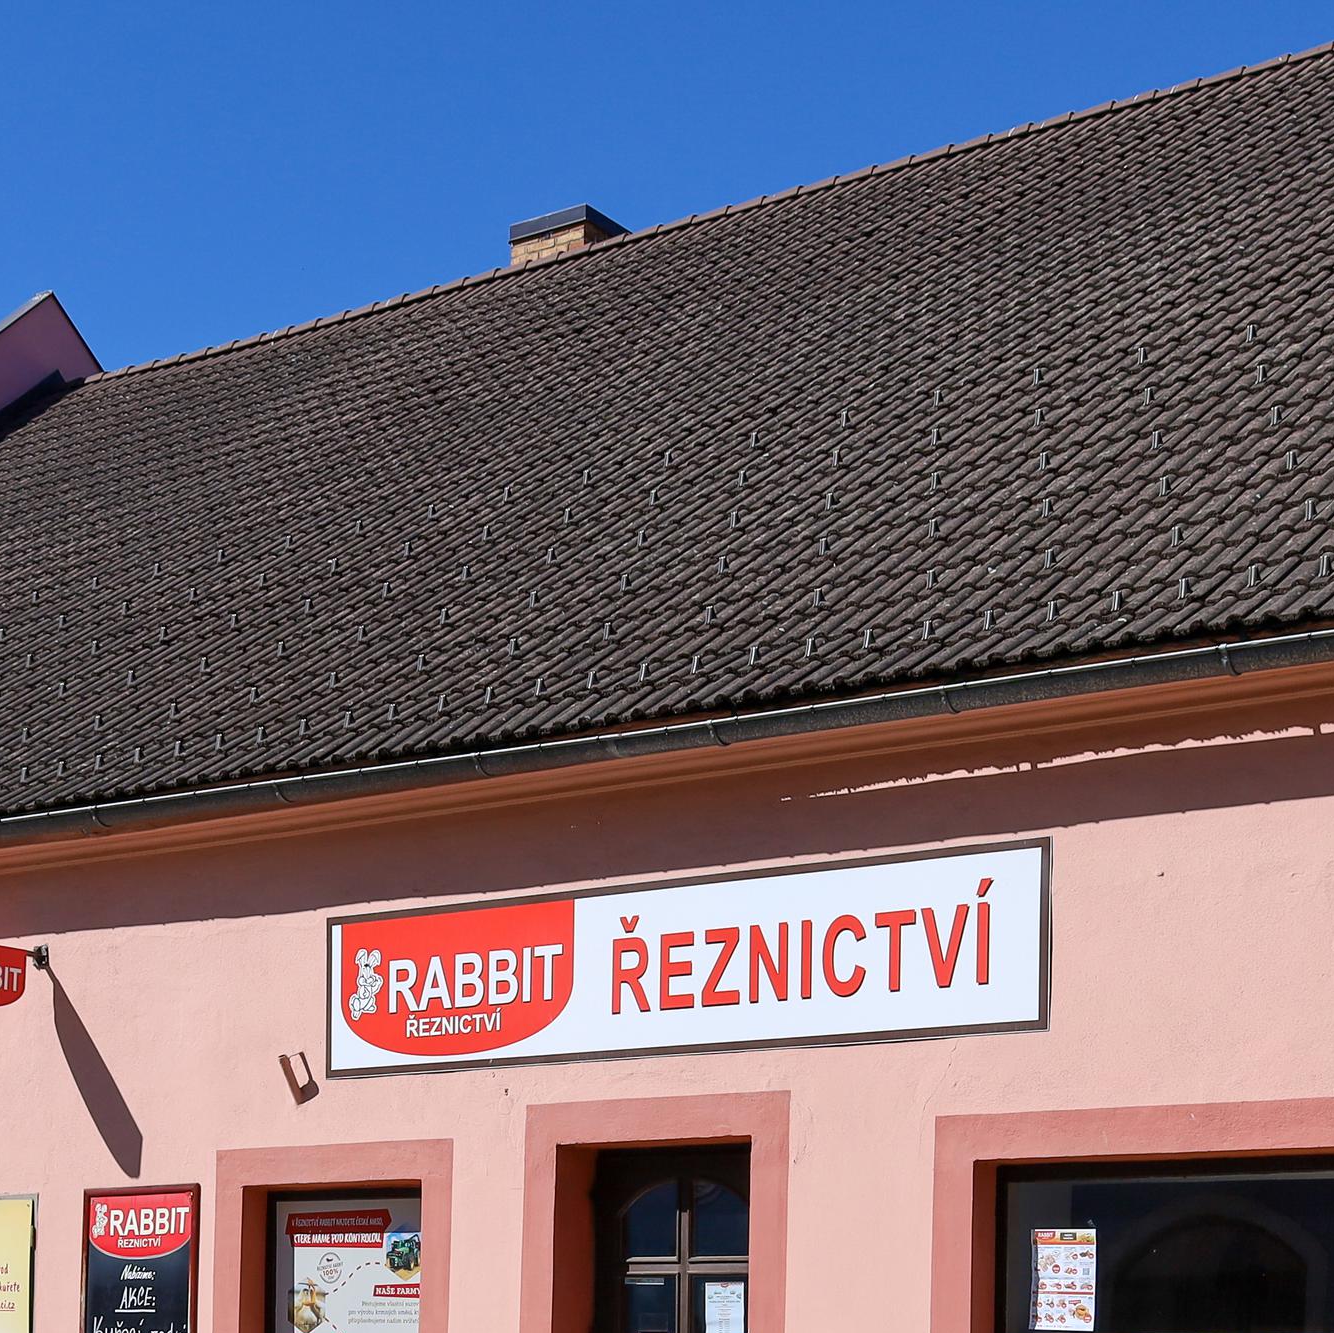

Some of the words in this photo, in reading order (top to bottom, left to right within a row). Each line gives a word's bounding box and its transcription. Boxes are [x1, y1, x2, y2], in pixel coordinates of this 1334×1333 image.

[611, 877, 994, 1015] ŘEZNICTVÍ
[388, 943, 564, 1015] RABBIT
[405, 1008, 502, 1038] ŘEZNICTVÍ
[109, 1206, 190, 1236] RABBIT
[117, 1236, 162, 1248] ŘEZNICTVÍ
[0, 1281, 21, 1292] kuřete
[119, 1286, 156, 1310] AKCE:
[375, 1286, 395, 1295] NAŠE
